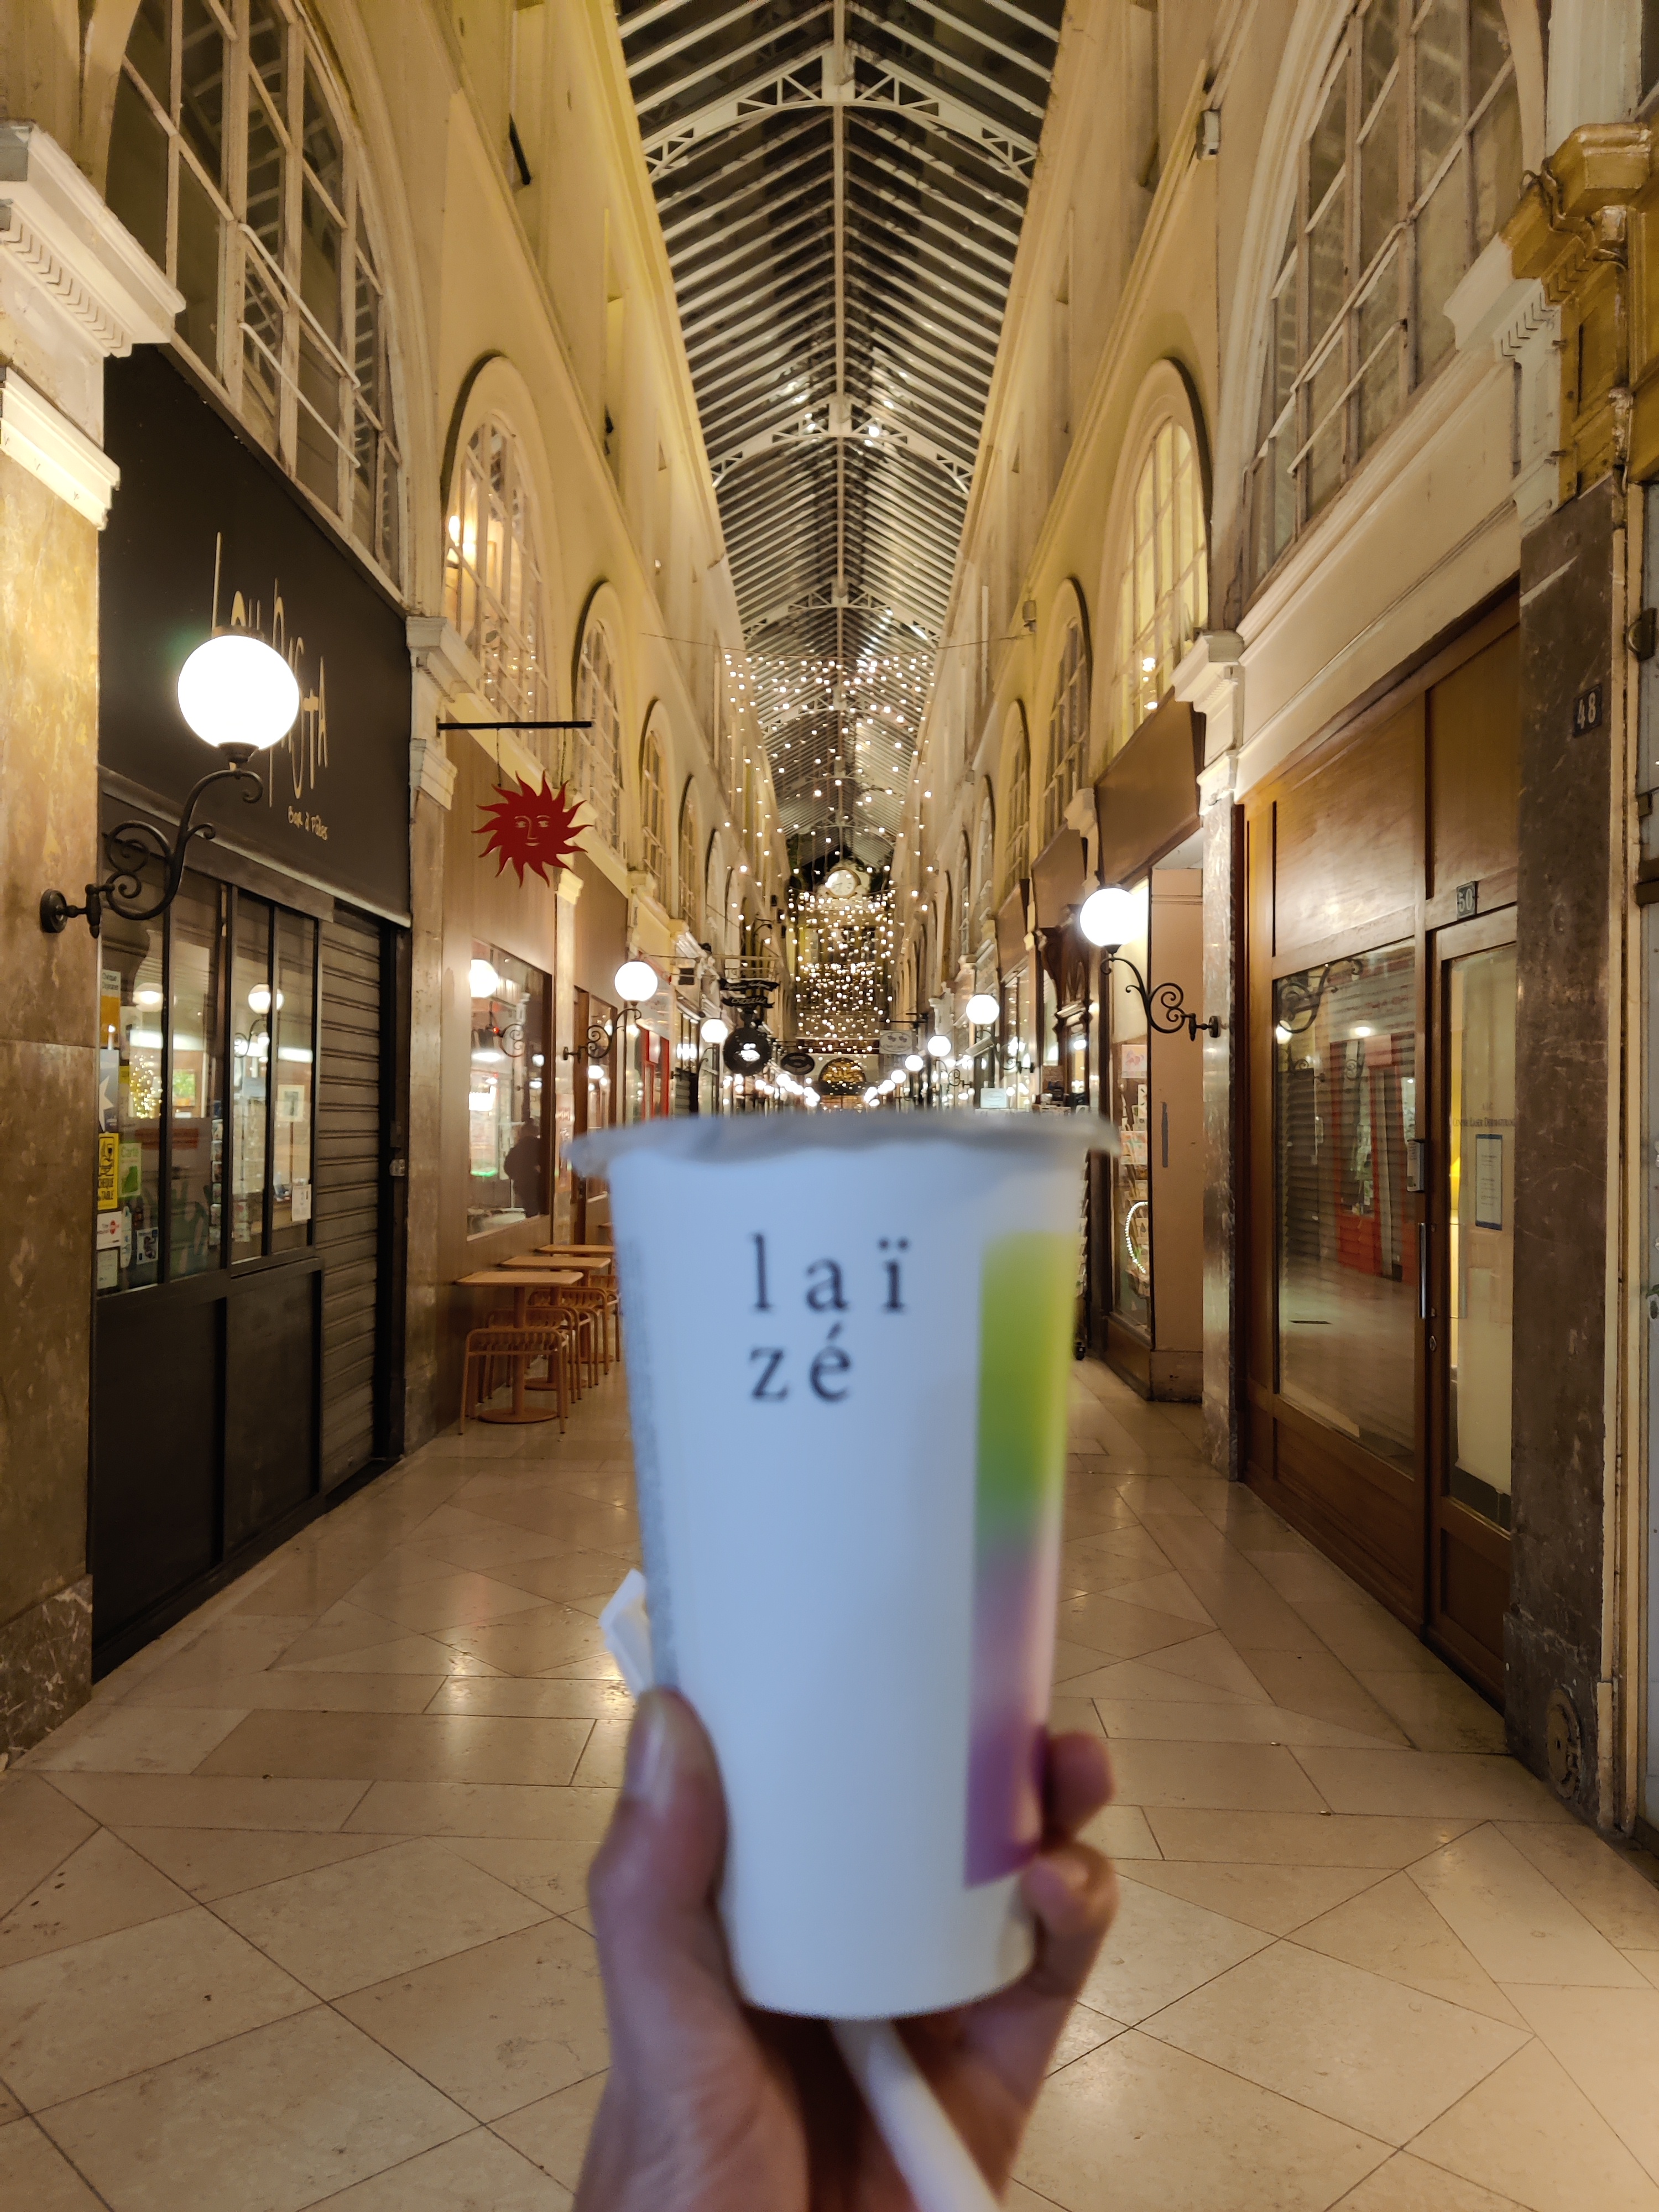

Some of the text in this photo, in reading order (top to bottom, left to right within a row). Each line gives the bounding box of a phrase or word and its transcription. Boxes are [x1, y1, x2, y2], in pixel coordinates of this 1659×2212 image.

[1577, 692, 1597, 729] 48
[1458, 888, 1473, 912] 50
[749, 1232, 910, 1312] laï
[749, 1322, 852, 1403] zé
